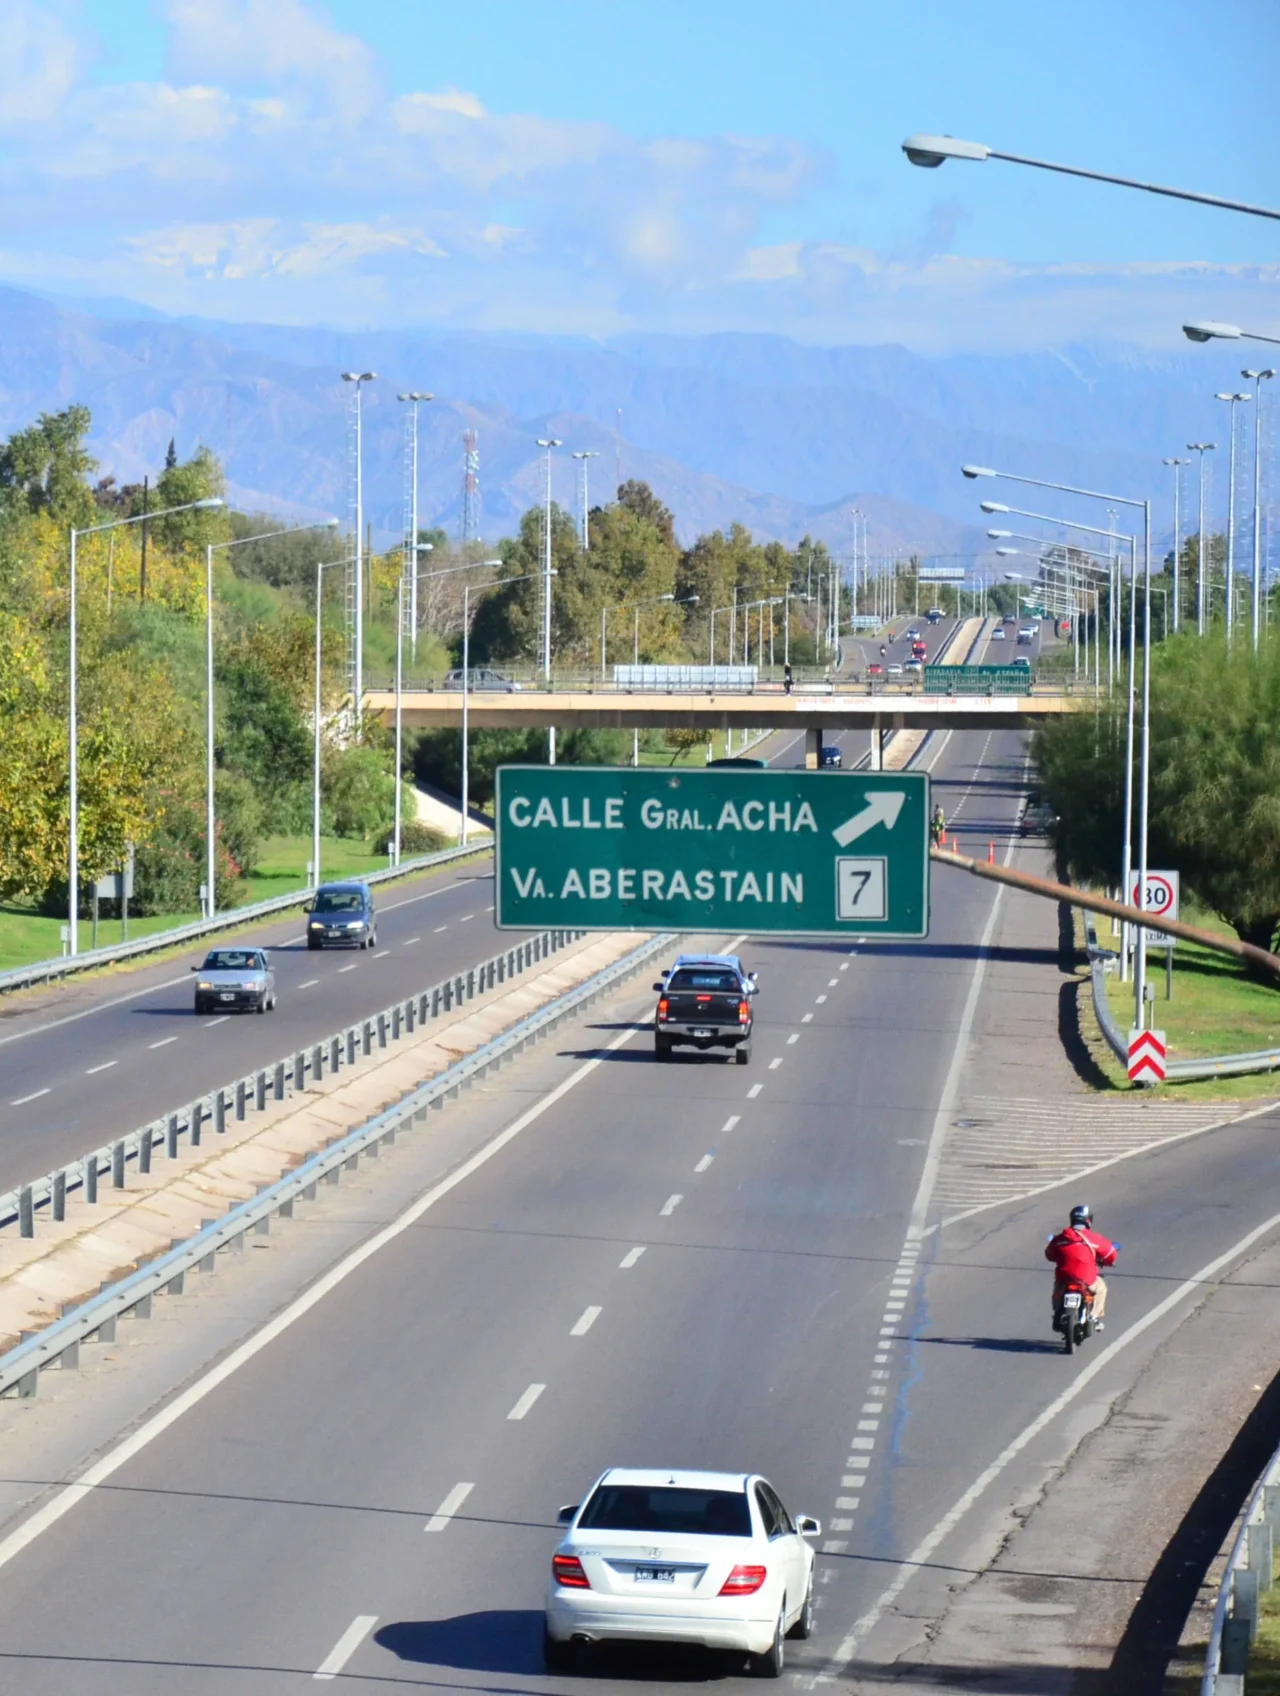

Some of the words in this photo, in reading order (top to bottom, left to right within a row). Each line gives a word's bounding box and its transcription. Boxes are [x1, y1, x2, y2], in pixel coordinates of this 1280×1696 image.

[508, 797, 625, 829] CALLE
[716, 801, 819, 833] ACHA
[559, 868, 804, 903] ABERASTAIN
[849, 870, 872, 906] 7
